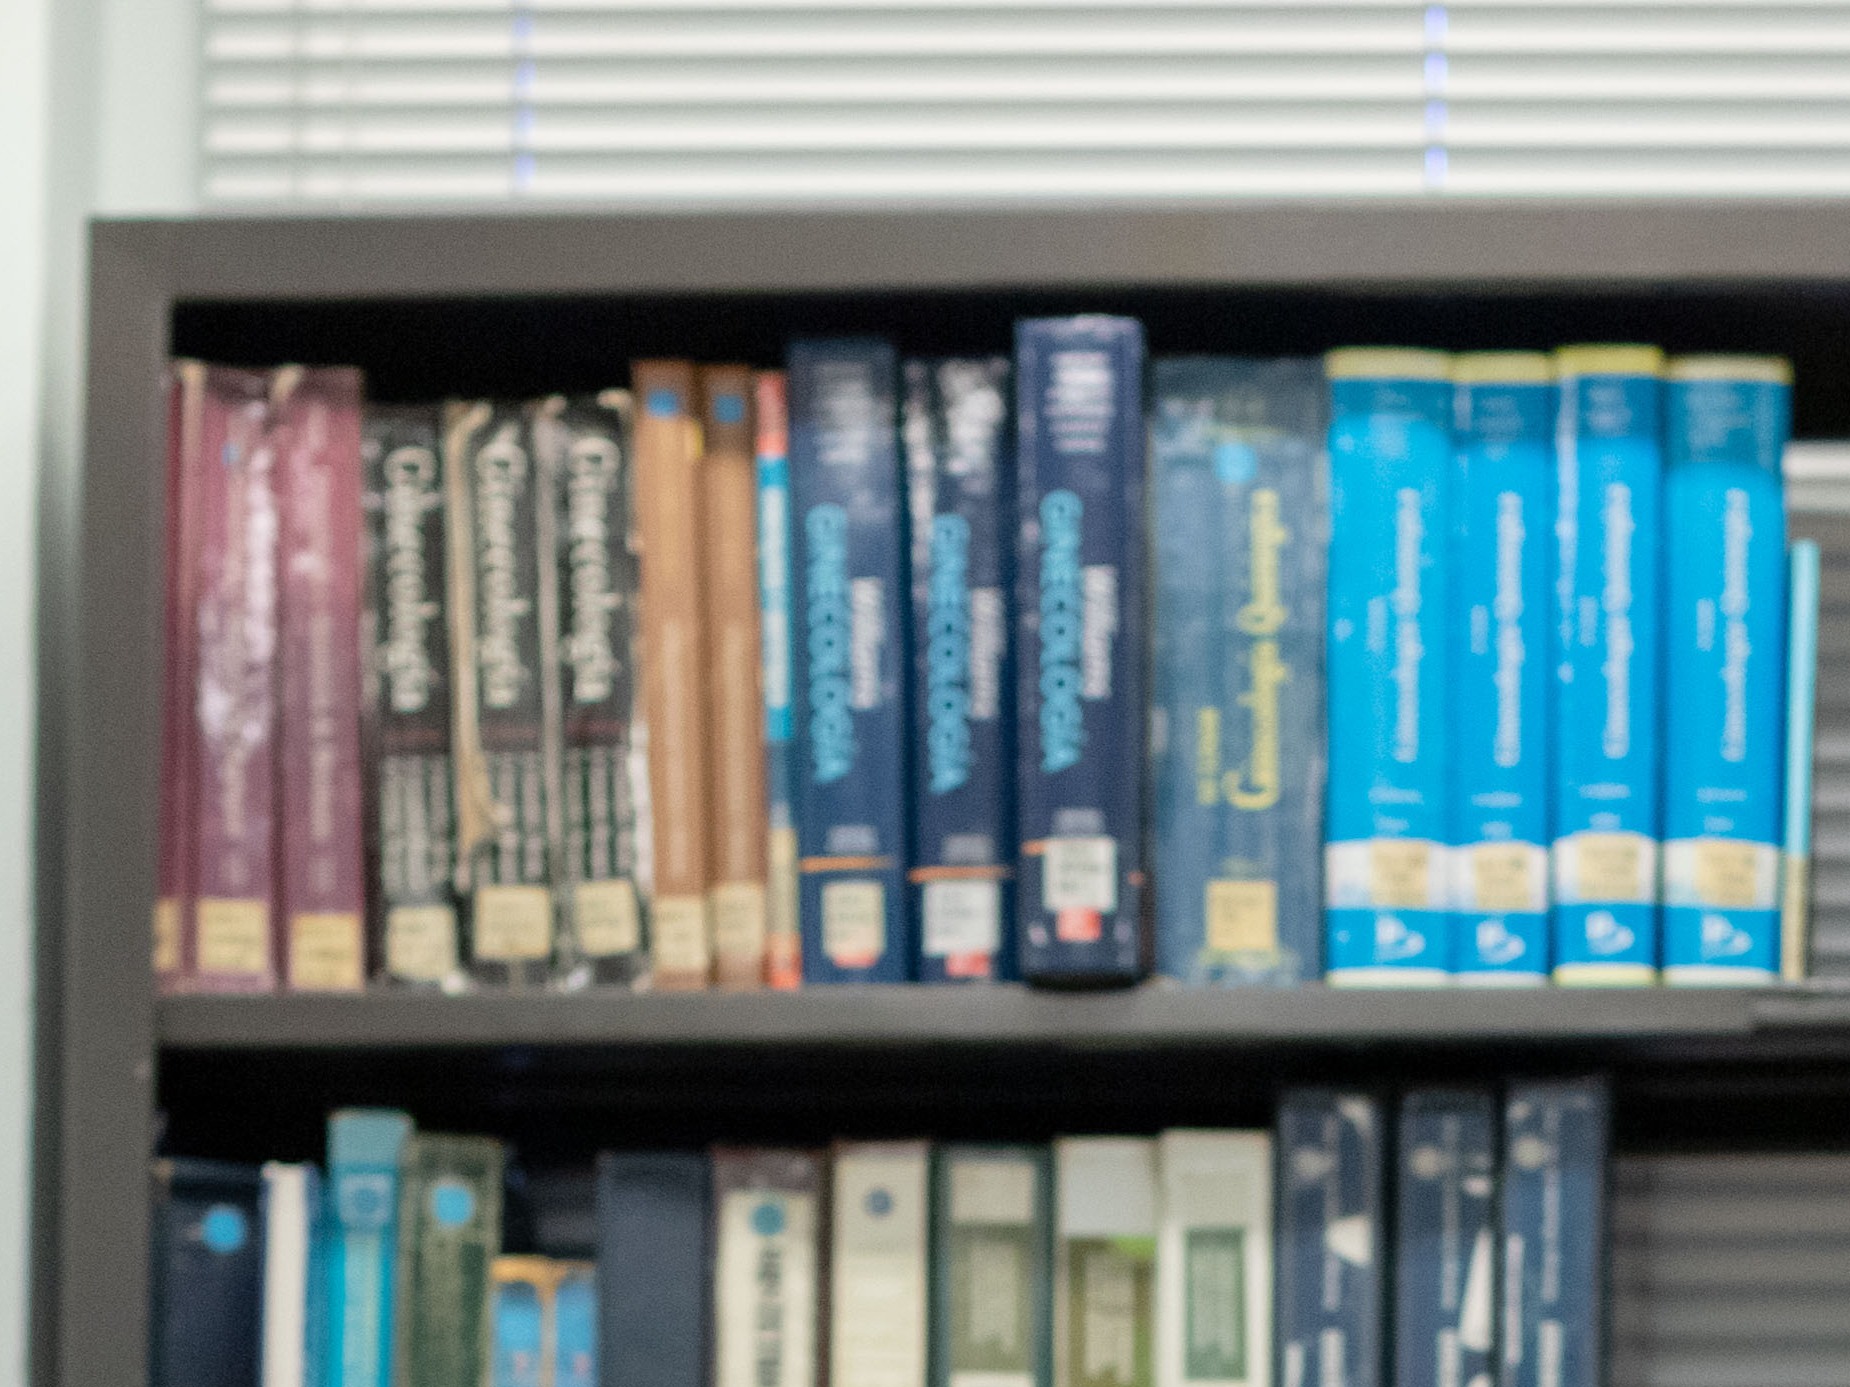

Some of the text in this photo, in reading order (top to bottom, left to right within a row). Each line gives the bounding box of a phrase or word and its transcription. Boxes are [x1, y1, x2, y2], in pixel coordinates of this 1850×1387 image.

[806, 502, 857, 784] GINECOLOGÍA
[928, 513, 971, 793] GINECOLOGÍA
[1039, 489, 1084, 773] GINECOLOGÍA
